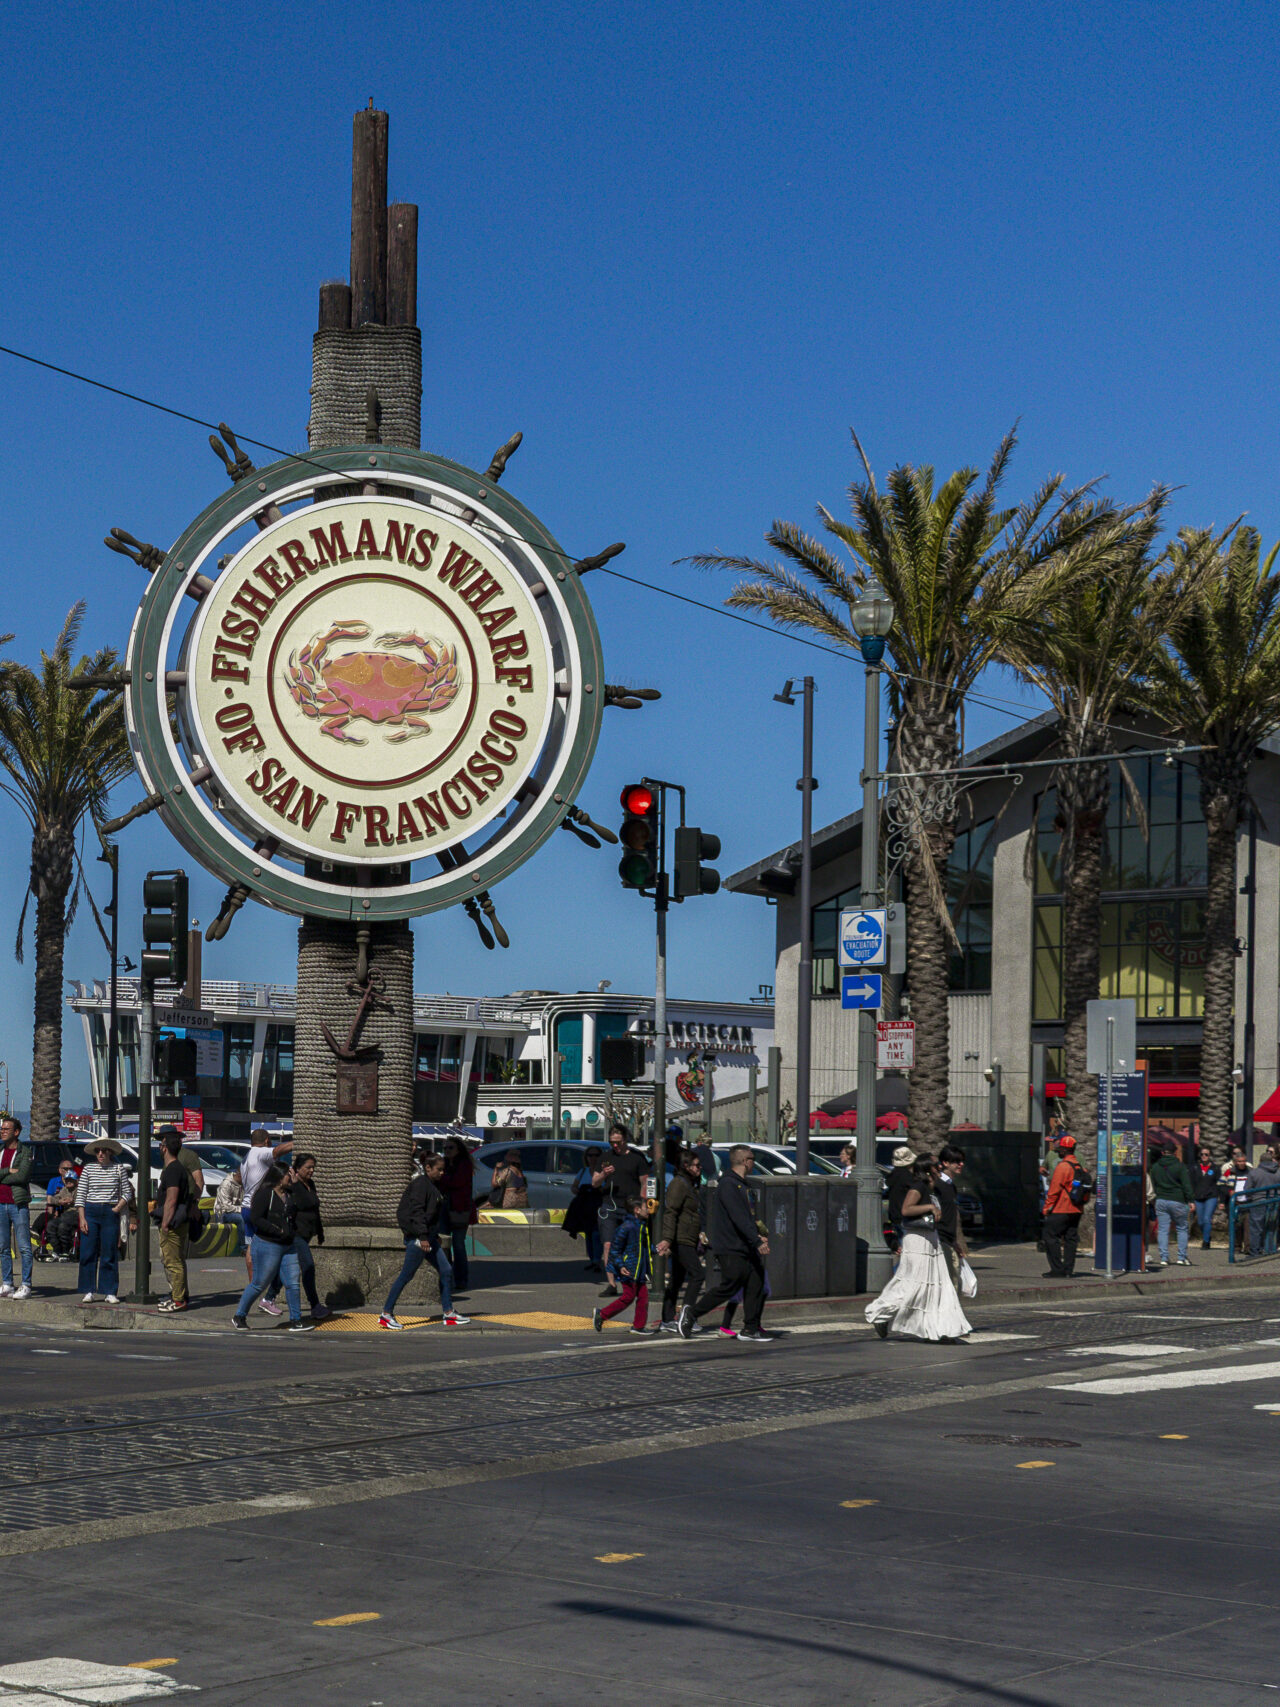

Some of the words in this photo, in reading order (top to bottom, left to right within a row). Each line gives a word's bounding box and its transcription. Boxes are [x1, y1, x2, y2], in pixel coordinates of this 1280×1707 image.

[211, 518, 439, 684] FISHERMANS
[437, 541, 534, 693] WHARF
[214, 702, 267, 755] OF
[245, 757, 329, 831] SAN
[330, 709, 528, 847] FRANCISCO
[845, 939, 879, 950] EVACUATION
[853, 948, 871, 958] ROUTE
[159, 1011, 209, 1026] Jefferson
[888, 1030, 913, 1041] STOPPING
[887, 1040, 904, 1050] ANY
[886, 1051, 905, 1060] TIME
